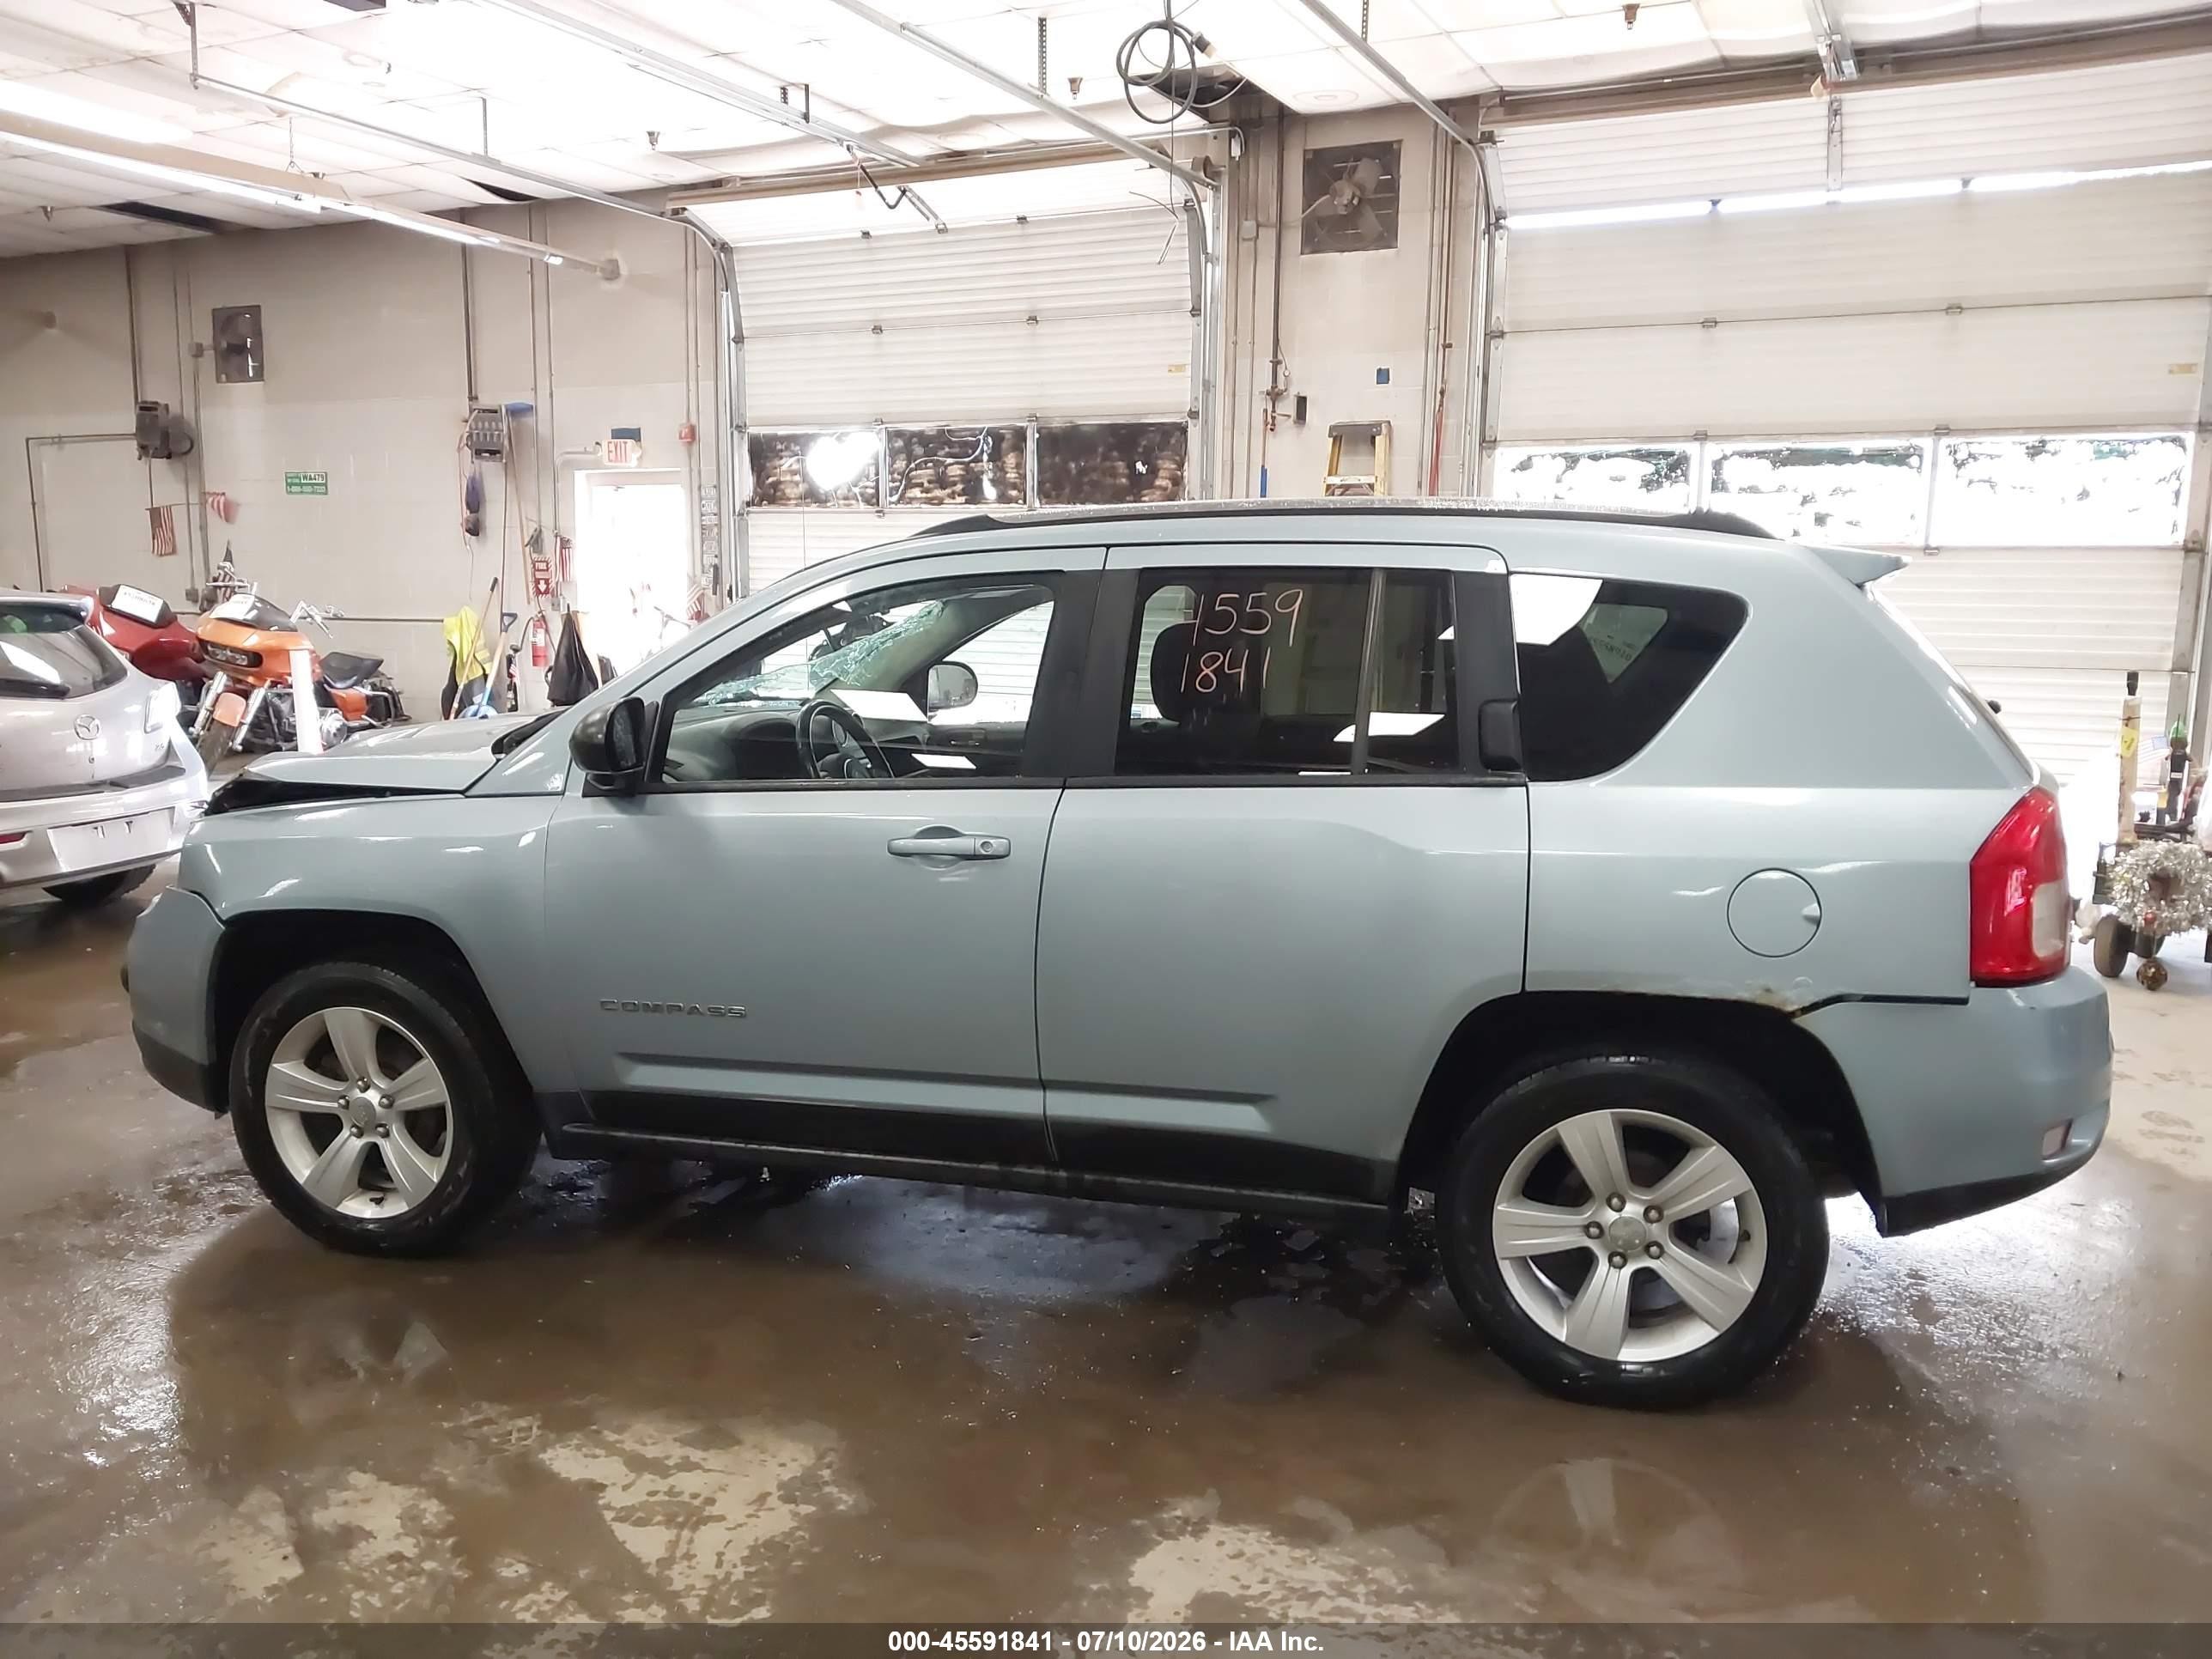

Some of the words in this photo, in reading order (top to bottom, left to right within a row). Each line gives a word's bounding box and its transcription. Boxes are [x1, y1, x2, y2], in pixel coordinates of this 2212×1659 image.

[607, 441, 628, 463] EXIT
[301, 473, 325, 482] WA479
[1180, 647, 1271, 693] 1841
[600, 999, 747, 1018] COMPASS
